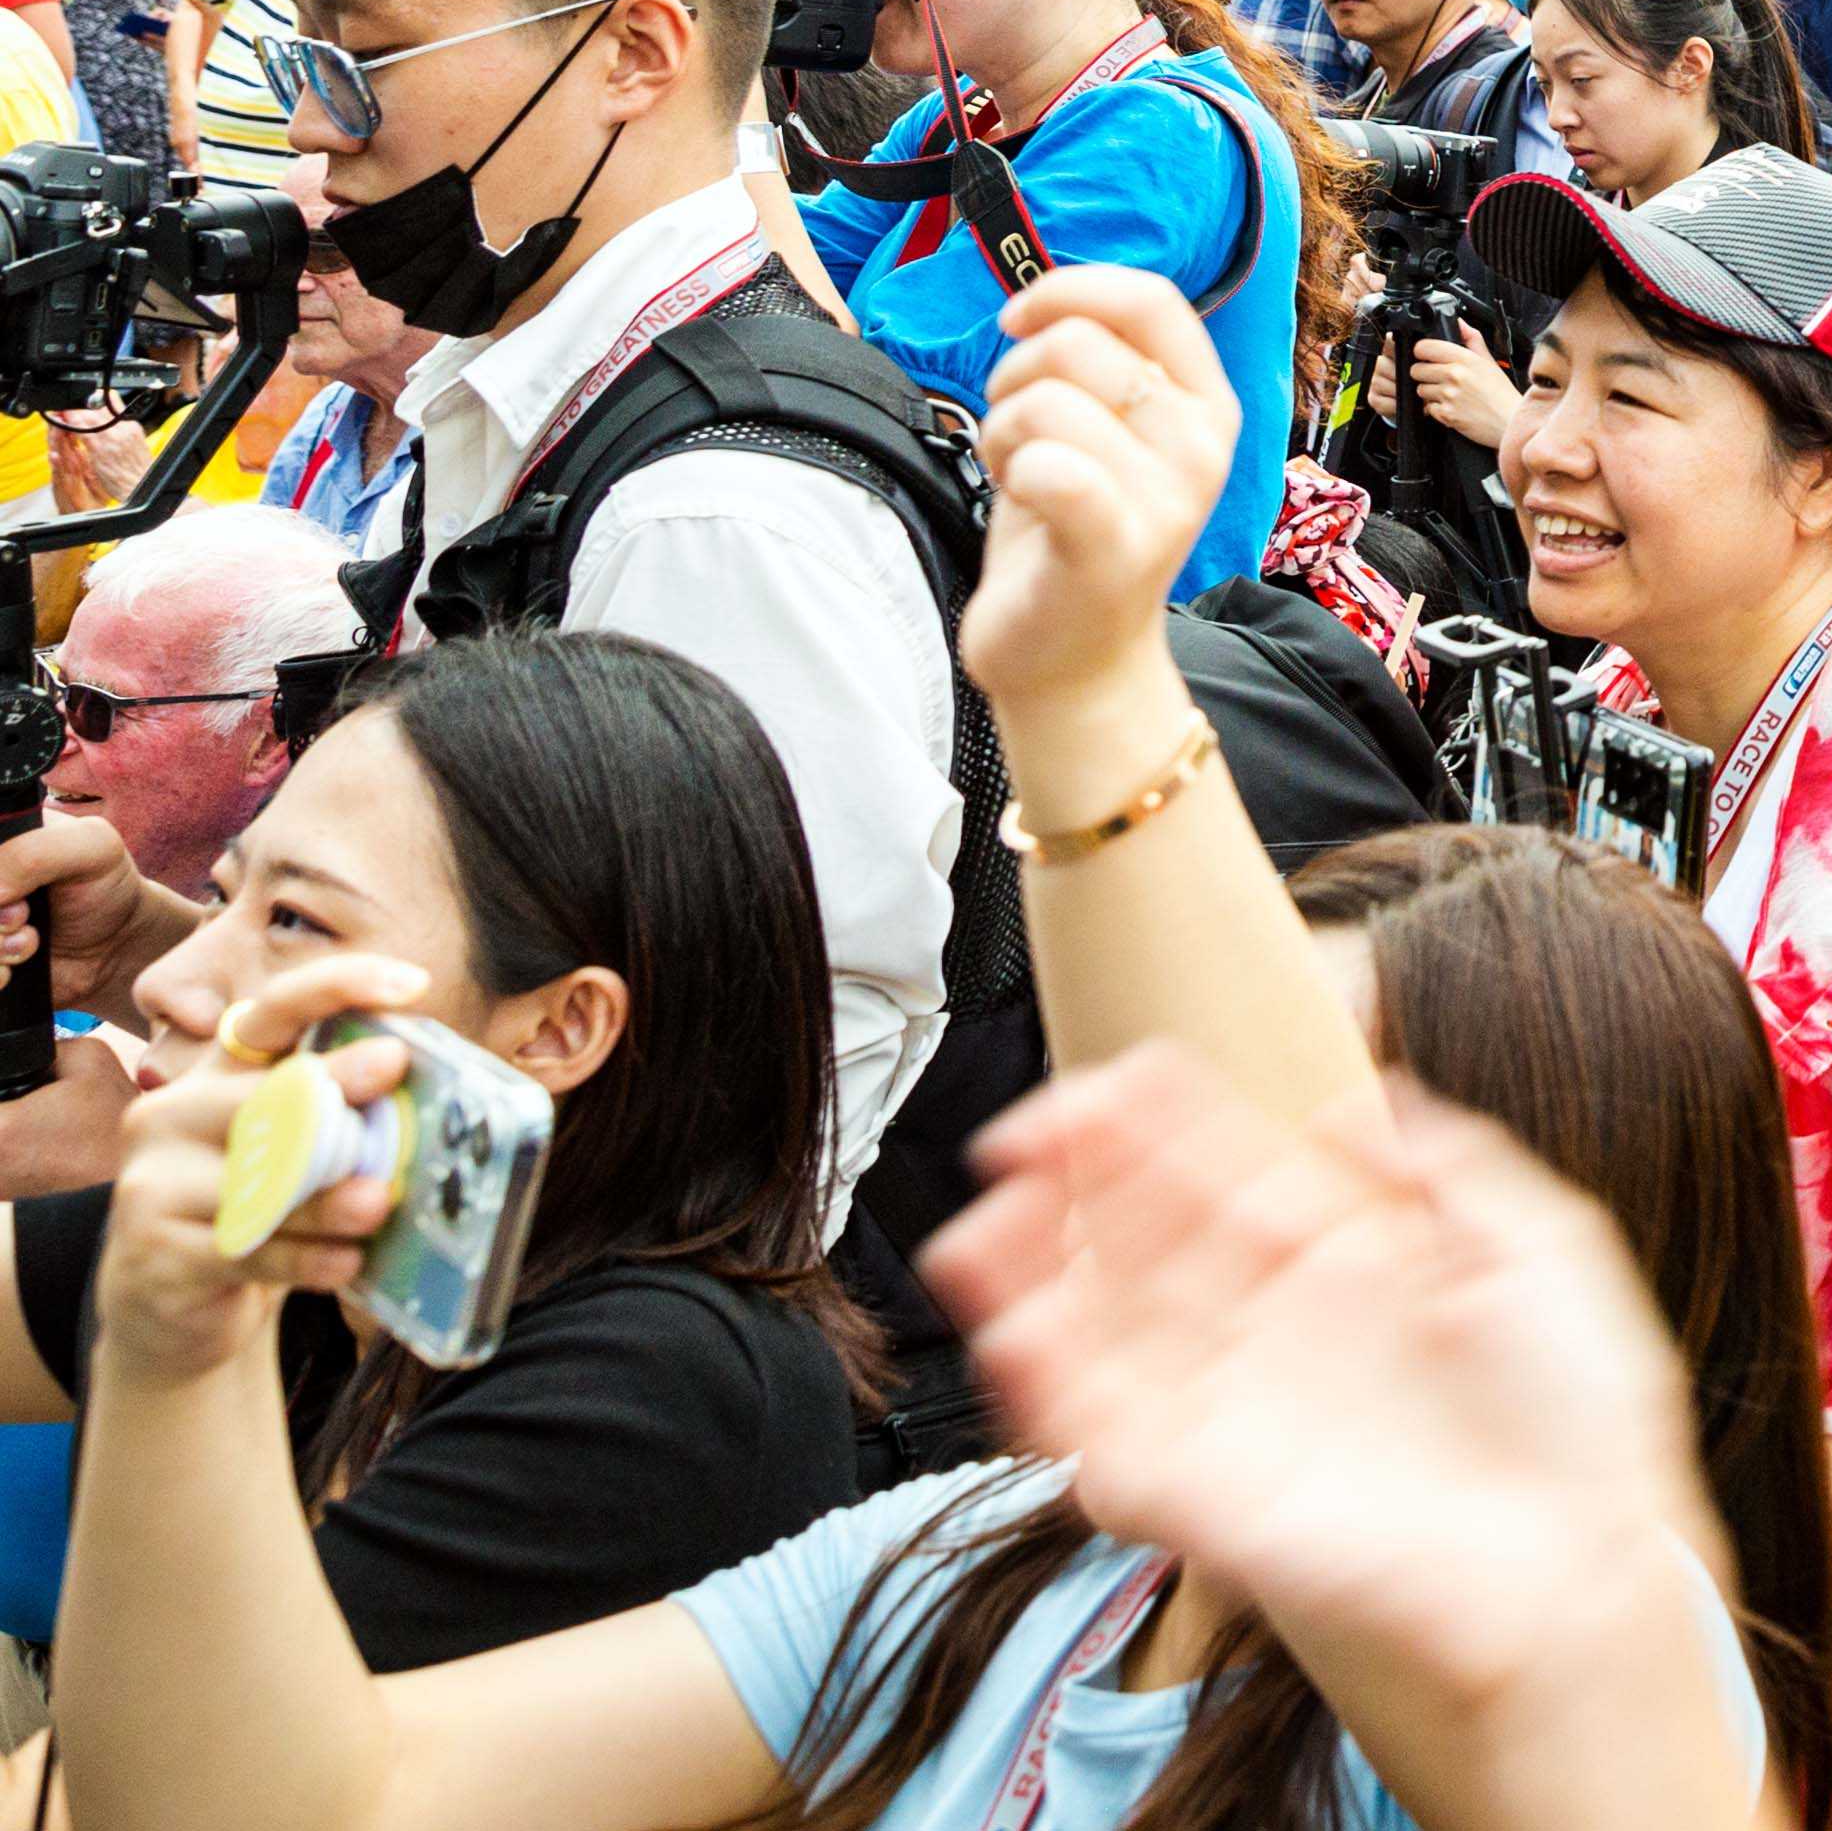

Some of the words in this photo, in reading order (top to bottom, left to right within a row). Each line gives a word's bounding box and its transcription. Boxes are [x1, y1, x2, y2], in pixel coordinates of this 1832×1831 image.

[1000, 232, 1048, 289] EO
[556, 399, 583, 432] TO
[584, 279, 711, 398] GREATNESS
[1733, 709, 1783, 778] RACE
[1714, 780, 1743, 813] TO
